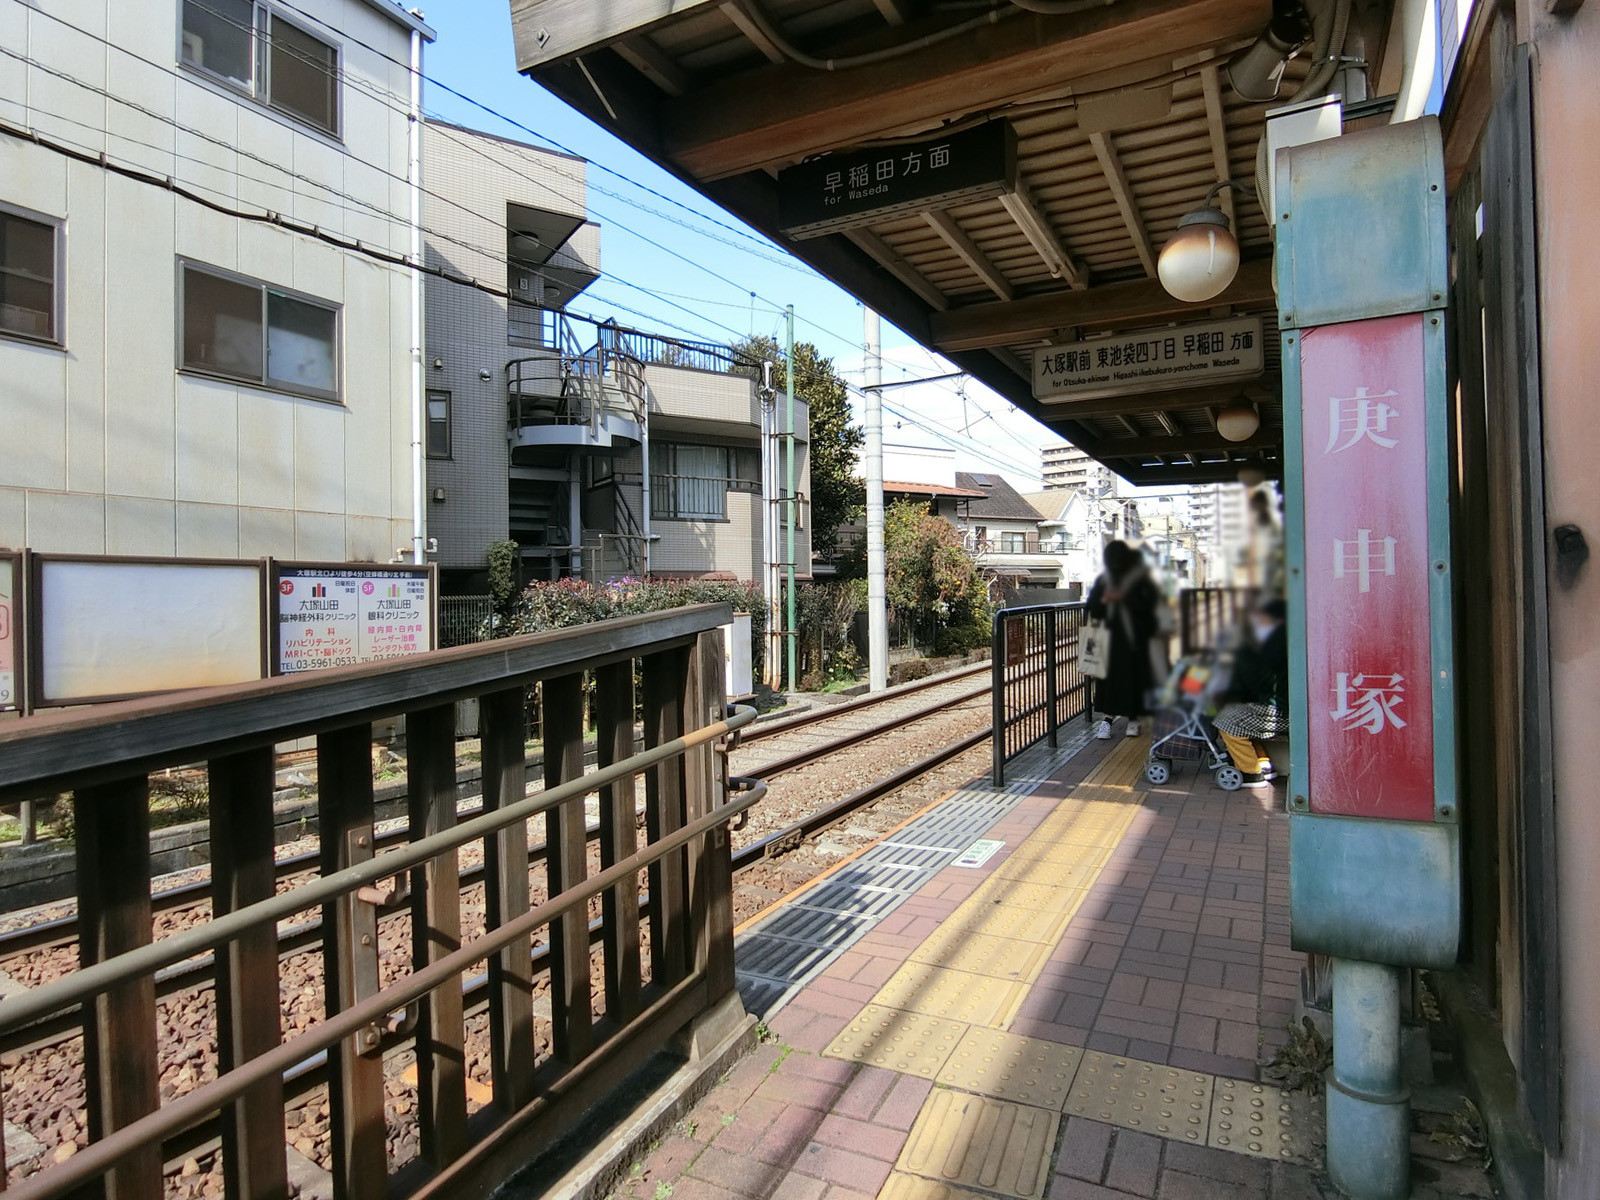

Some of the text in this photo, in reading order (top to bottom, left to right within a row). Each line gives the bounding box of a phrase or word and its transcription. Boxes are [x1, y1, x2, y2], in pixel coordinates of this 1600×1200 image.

[823, 144, 951, 193] 早稲田方面
[824, 184, 889, 207] for Waseda
[1042, 330, 1255, 376] 大塚駅前 東池袋四丁目 早稲田 方面
[1053, 379, 1062, 388] for
[1063, 374, 1110, 387] Otsuka-ekimae
[1212, 356, 1240, 369] Waseda
[1324, 386, 1407, 734] 庚申塚
[281, 583, 293, 592] 3F
[363, 584, 373, 592] 5F
[299, 600, 339, 611] 大塚山田
[377, 599, 411, 610] 大塚山田
[280, 613, 356, 623] 脳神経外科クリニック
[368, 611, 419, 621] 眼科クリニック
[286, 637, 351, 647] リハビリテーション
[373, 633, 415, 643] レーザー治療
[371, 643, 417, 653] コンタクト処方
[1, 689, 10, 701] 9
